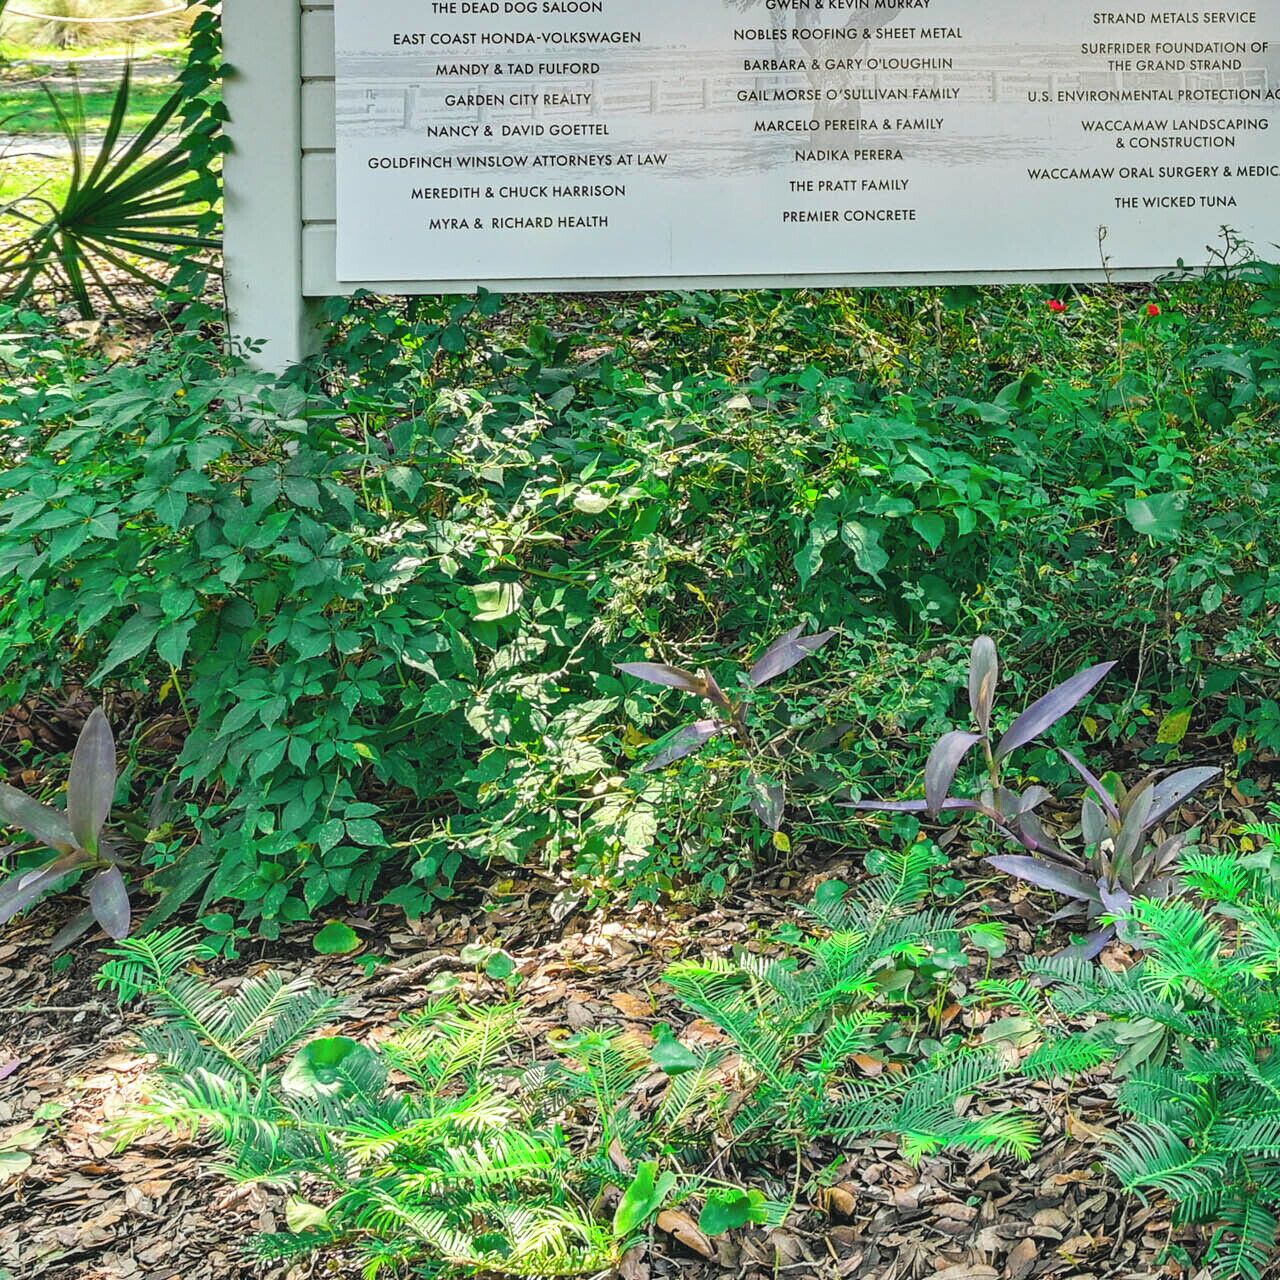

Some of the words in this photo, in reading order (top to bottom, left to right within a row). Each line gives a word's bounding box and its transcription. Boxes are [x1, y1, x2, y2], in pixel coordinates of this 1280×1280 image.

[431, 2, 457, 14] THE
[461, 2, 500, 14] DEAD
[504, 1, 538, 14] DOG
[542, 1, 603, 13] SALOON
[1093, 13, 1146, 24] STRAND
[1150, 12, 1199, 24] METALS
[1203, 12, 1256, 23] SERVICE
[393, 33, 426, 45] EAST
[430, 33, 477, 45] COAST
[481, 31, 641, 44] HONDA-VOLKSWAGEN
[1081, 43, 1151, 54] SURFRIDER
[1155, 42, 1246, 54] FOUNDATION
[1250, 41, 1269, 53] OF
[435, 63, 489, 76] MANDY
[493, 63, 504, 75] &
[507, 63, 534, 75] TAD
[538, 62, 600, 75] FULFORD
[744, 59, 807, 71] BARBARA
[811, 59, 821, 70] &
[824, 58, 863, 70] GARY
[866, 58, 953, 70] O'LOUGHLIN
[1108, 60, 1131, 71] THE
[1136, 59, 1186, 71] GRAND
[1190, 59, 1242, 71] STRAND
[1028, 91, 1053, 102] U.S.
[1058, 90, 1173, 102] ENVIRONMENTAL
[1178, 89, 1260, 101] PROTECTION
[754, 119, 820, 132] MARCELO
[824, 119, 878, 131] PEREIRA
[882, 119, 892, 130] &
[896, 118, 944, 130] FAMILY
[1081, 120, 1168, 132] WACCAMAW
[1173, 118, 1269, 131] LANDSCAPING
[1116, 137, 1125, 149] &
[1129, 136, 1235, 149] CONSTRUCTION
[368, 156, 452, 169] GOLDFINCH
[456, 155, 529, 168] WINSLOW
[532, 154, 613, 167] ATTORNEYS
[616, 154, 633, 166] AT
[637, 154, 668, 166] LAW
[795, 149, 850, 162] NADIKA
[854, 149, 903, 161] PERERA
[1027, 167, 1115, 180] WACCAMAW
[1118, 167, 1155, 179] ORAL
[1158, 166, 1219, 178] SURGERY
[1223, 166, 1232, 177] &
[789, 180, 814, 192] THE
[818, 180, 857, 192] PRATT
[861, 179, 909, 191] FAMILY
[411, 187, 480, 200] MEREDITH
[485, 186, 495, 198] &
[499, 186, 548, 198] CHUCK
[552, 185, 625, 197] HARRISON
[1114, 197, 1138, 209] THE
[1142, 196, 1196, 208] WICKED
[1199, 196, 1237, 207] TUNA
[783, 210, 839, 223] PREMIER
[843, 209, 916, 222] CONCRETE
[429, 218, 469, 230] MYRA
[473, 217, 483, 229] &
[492, 216, 553, 229] RICHARD
[558, 216, 608, 228] HEALTH
